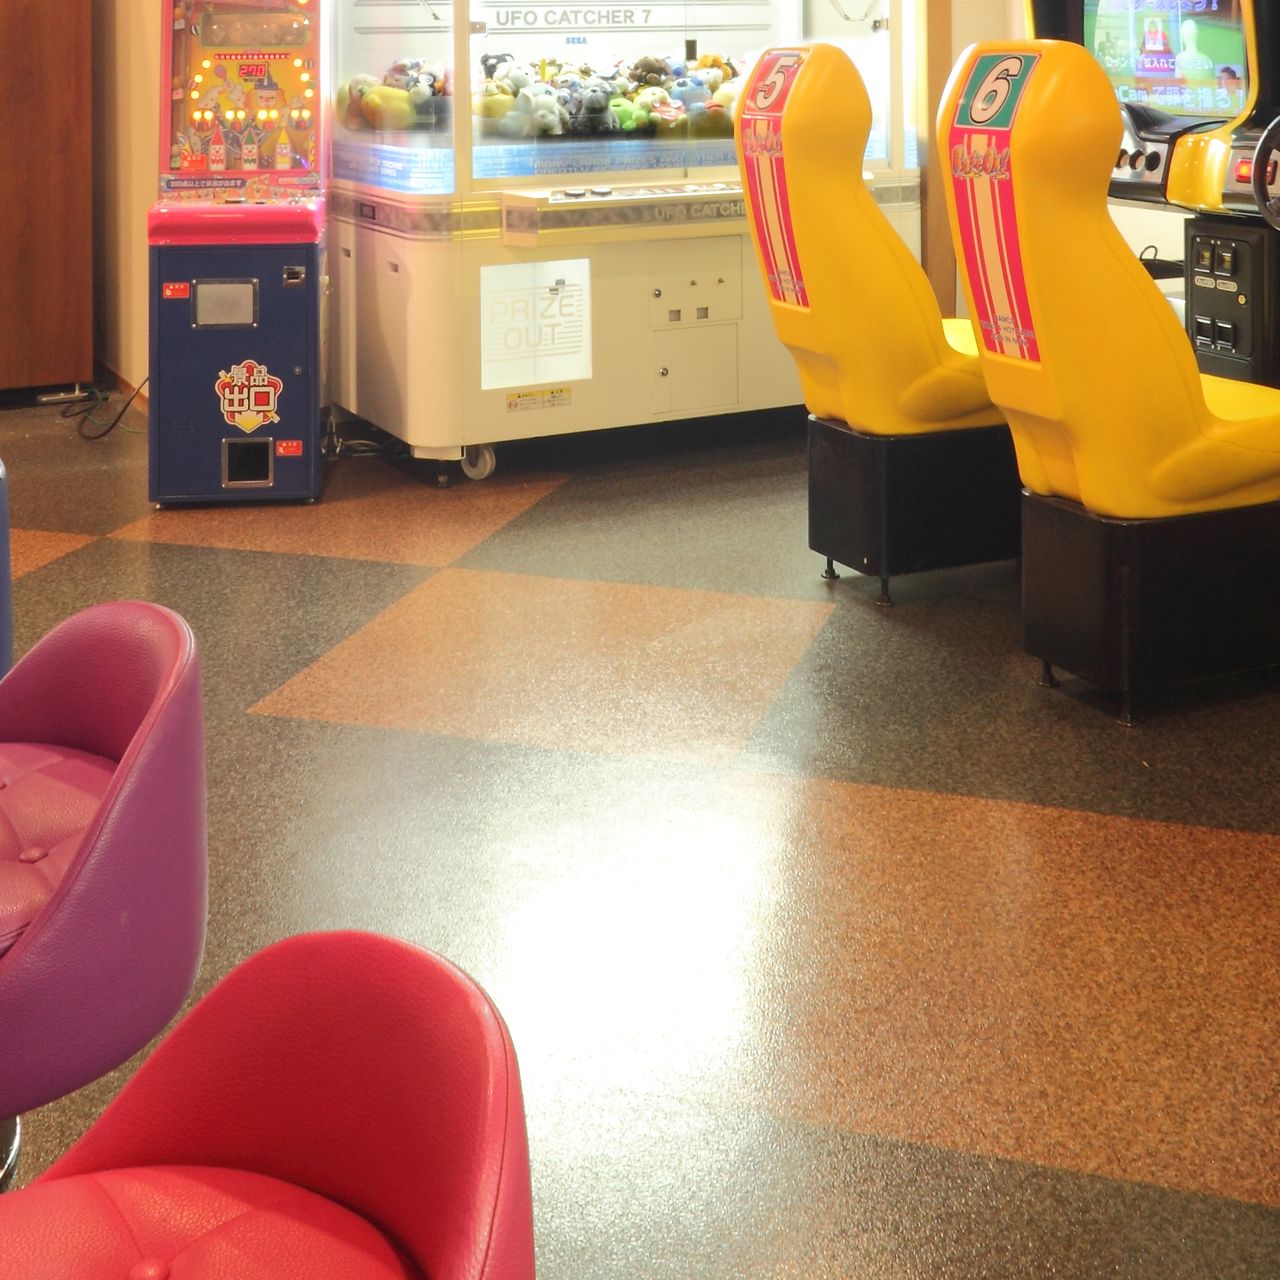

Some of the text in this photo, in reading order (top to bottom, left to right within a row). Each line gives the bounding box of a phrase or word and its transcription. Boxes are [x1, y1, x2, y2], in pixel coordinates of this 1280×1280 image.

[495, 9, 651, 27] UFO CATCHER 7
[240, 65, 266, 78] 270
[755, 54, 801, 110] 5
[969, 56, 1023, 124] 6
[490, 294, 575, 322] PRIZE
[504, 323, 562, 351] OUT
[232, 367, 269, 386] 景品
[224, 387, 275, 412] 出口
